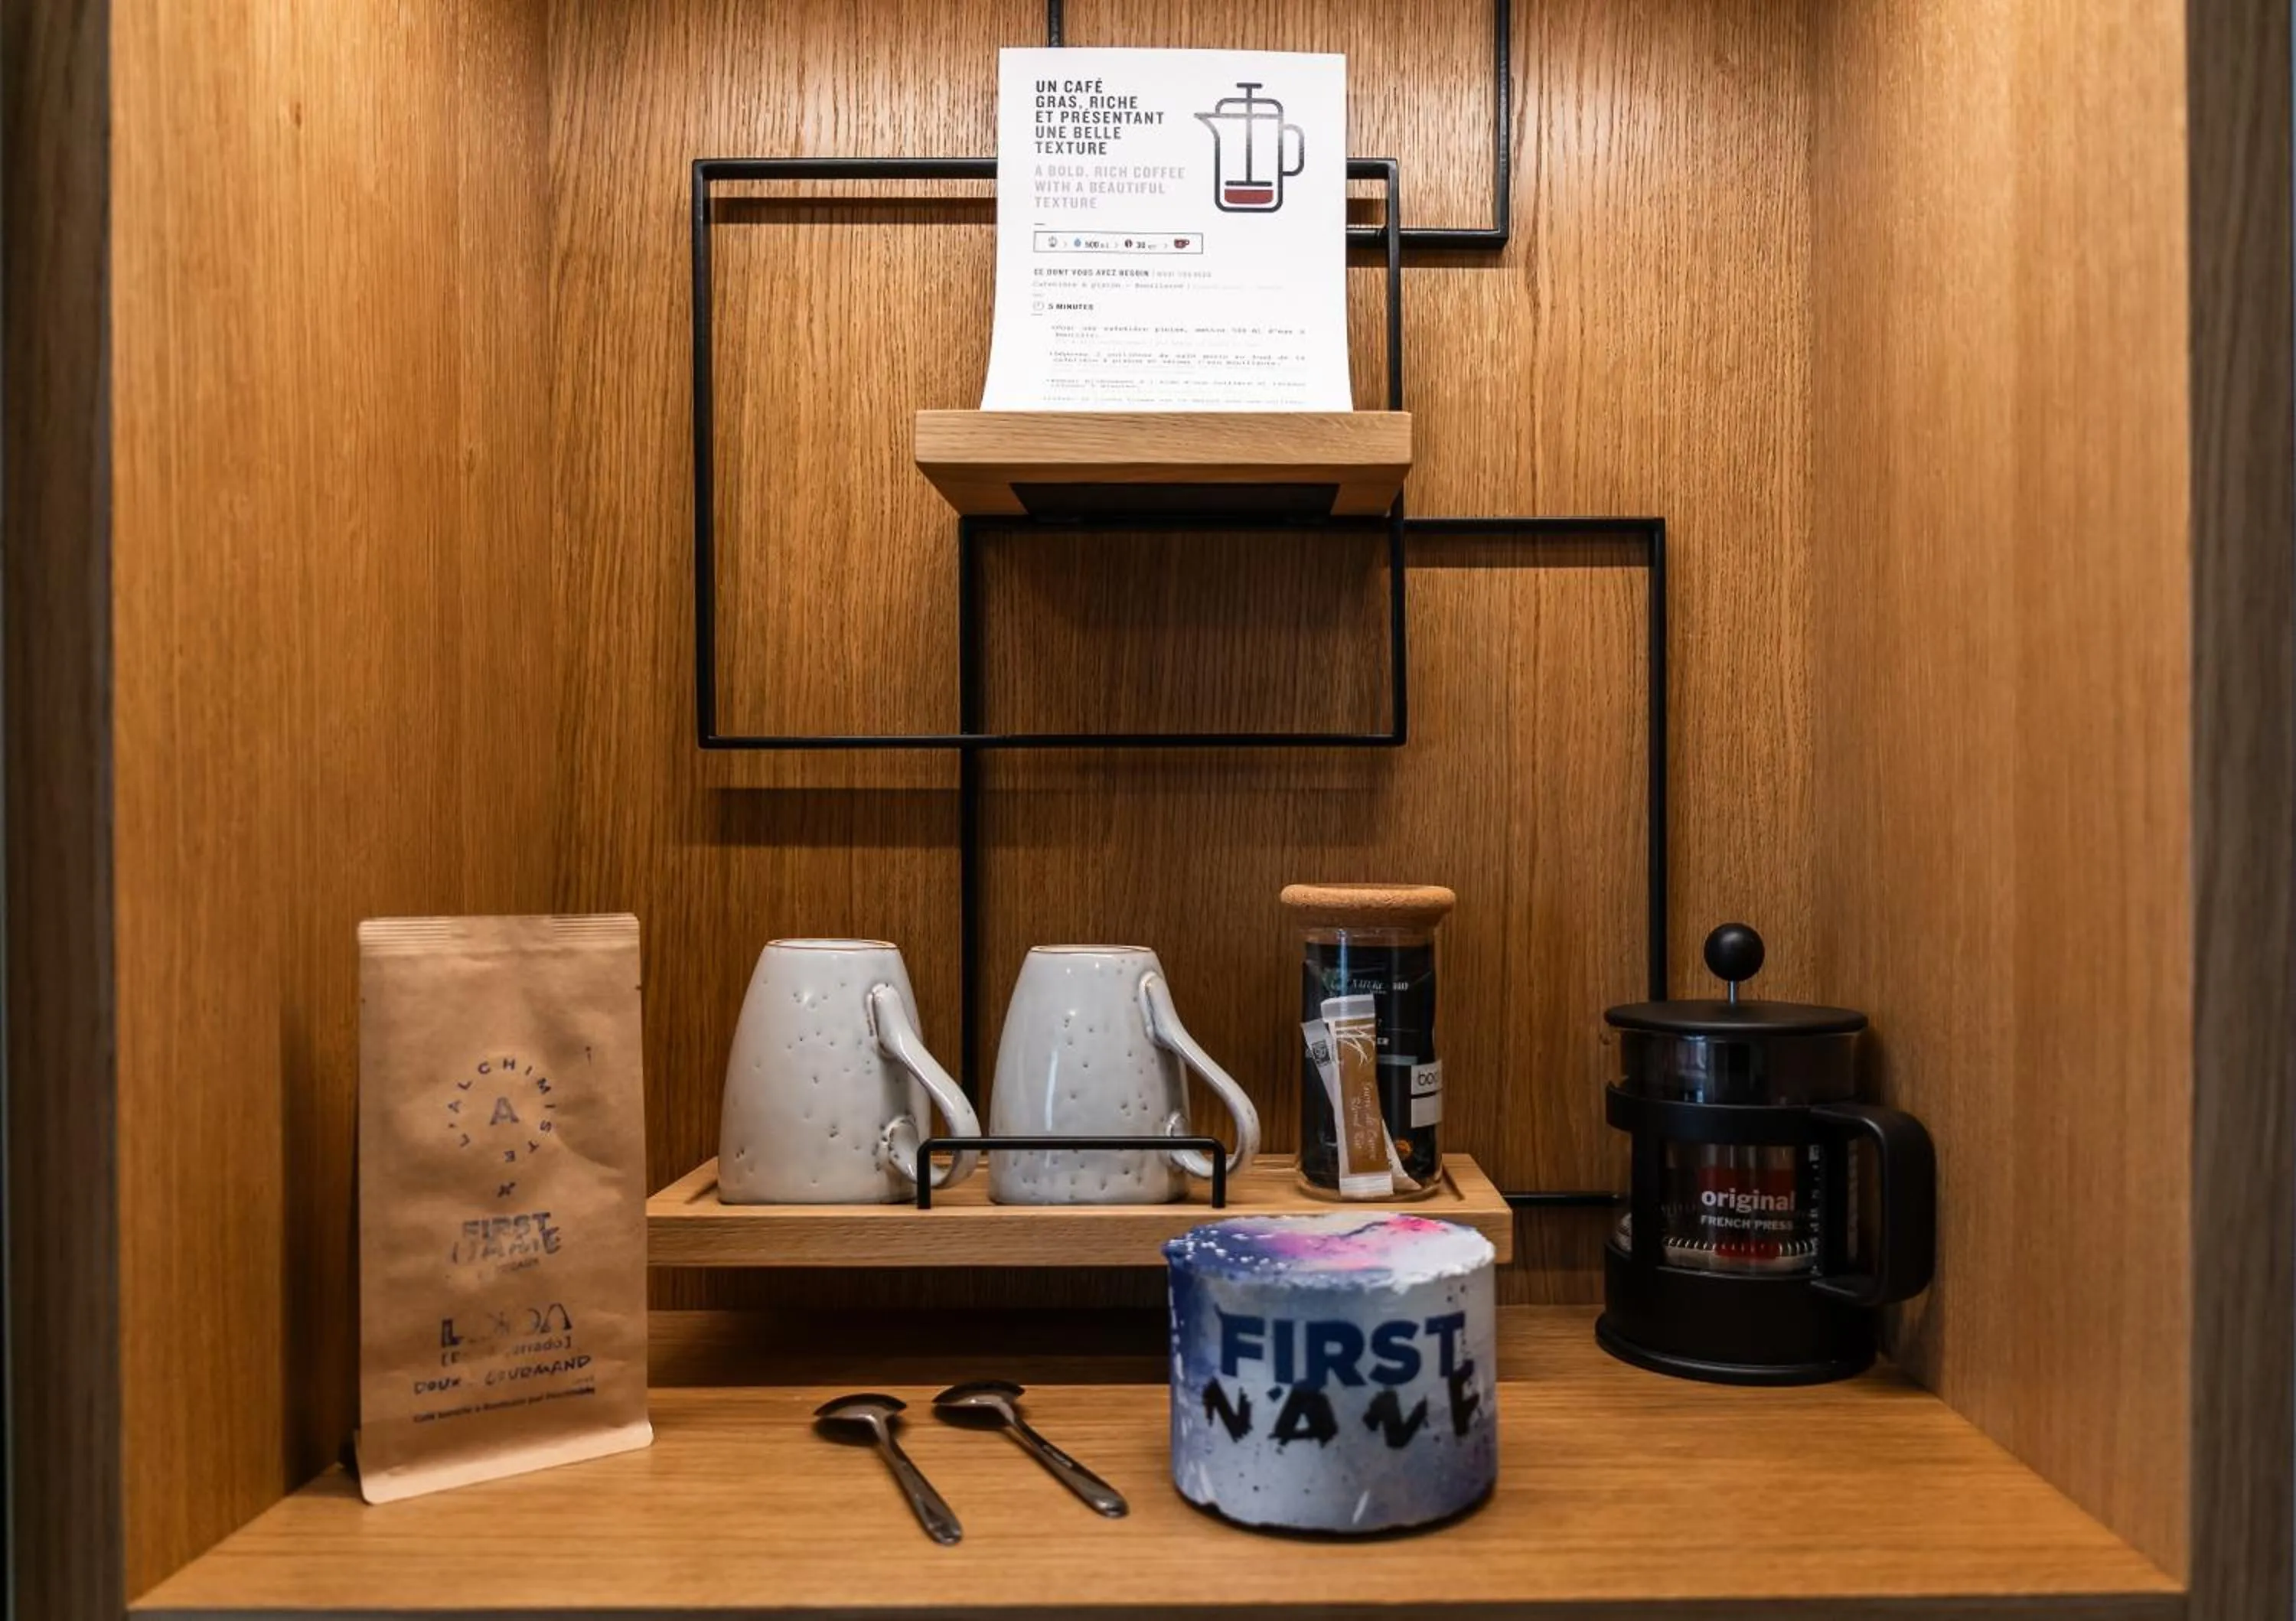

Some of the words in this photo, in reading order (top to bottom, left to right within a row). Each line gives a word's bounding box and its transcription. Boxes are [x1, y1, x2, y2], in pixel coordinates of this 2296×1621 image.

[1035, 80, 1057, 93] UN
[1064, 77, 1103, 93] CAFÉ
[1035, 95, 1083, 109] GRAS,
[1090, 96, 1138, 109] RICHE
[1035, 110, 1053, 123] ET
[1061, 108, 1164, 124] PRÉSENTANT
[1035, 126, 1066, 139] UNE
[1074, 126, 1121, 139] BELLE
[1035, 141, 1107, 155] TEXTURE
[1035, 165, 1043, 178] A
[1094, 165, 1127, 178] RICH
[1133, 166, 1186, 179] COFFEE
[1035, 181, 1071, 192] WITH
[1075, 181, 1084, 192] A
[1089, 181, 1166, 194] BEAUTIFUL
[1035, 196, 1097, 208] TEXTURE
[1701, 1187, 1796, 1213] original
[462, 1212, 551, 1239] FIRST
[1701, 1215, 1750, 1229] FRENCH
[1754, 1218, 1794, 1231] PRESS
[1215, 1306, 1466, 1387] FIRST
